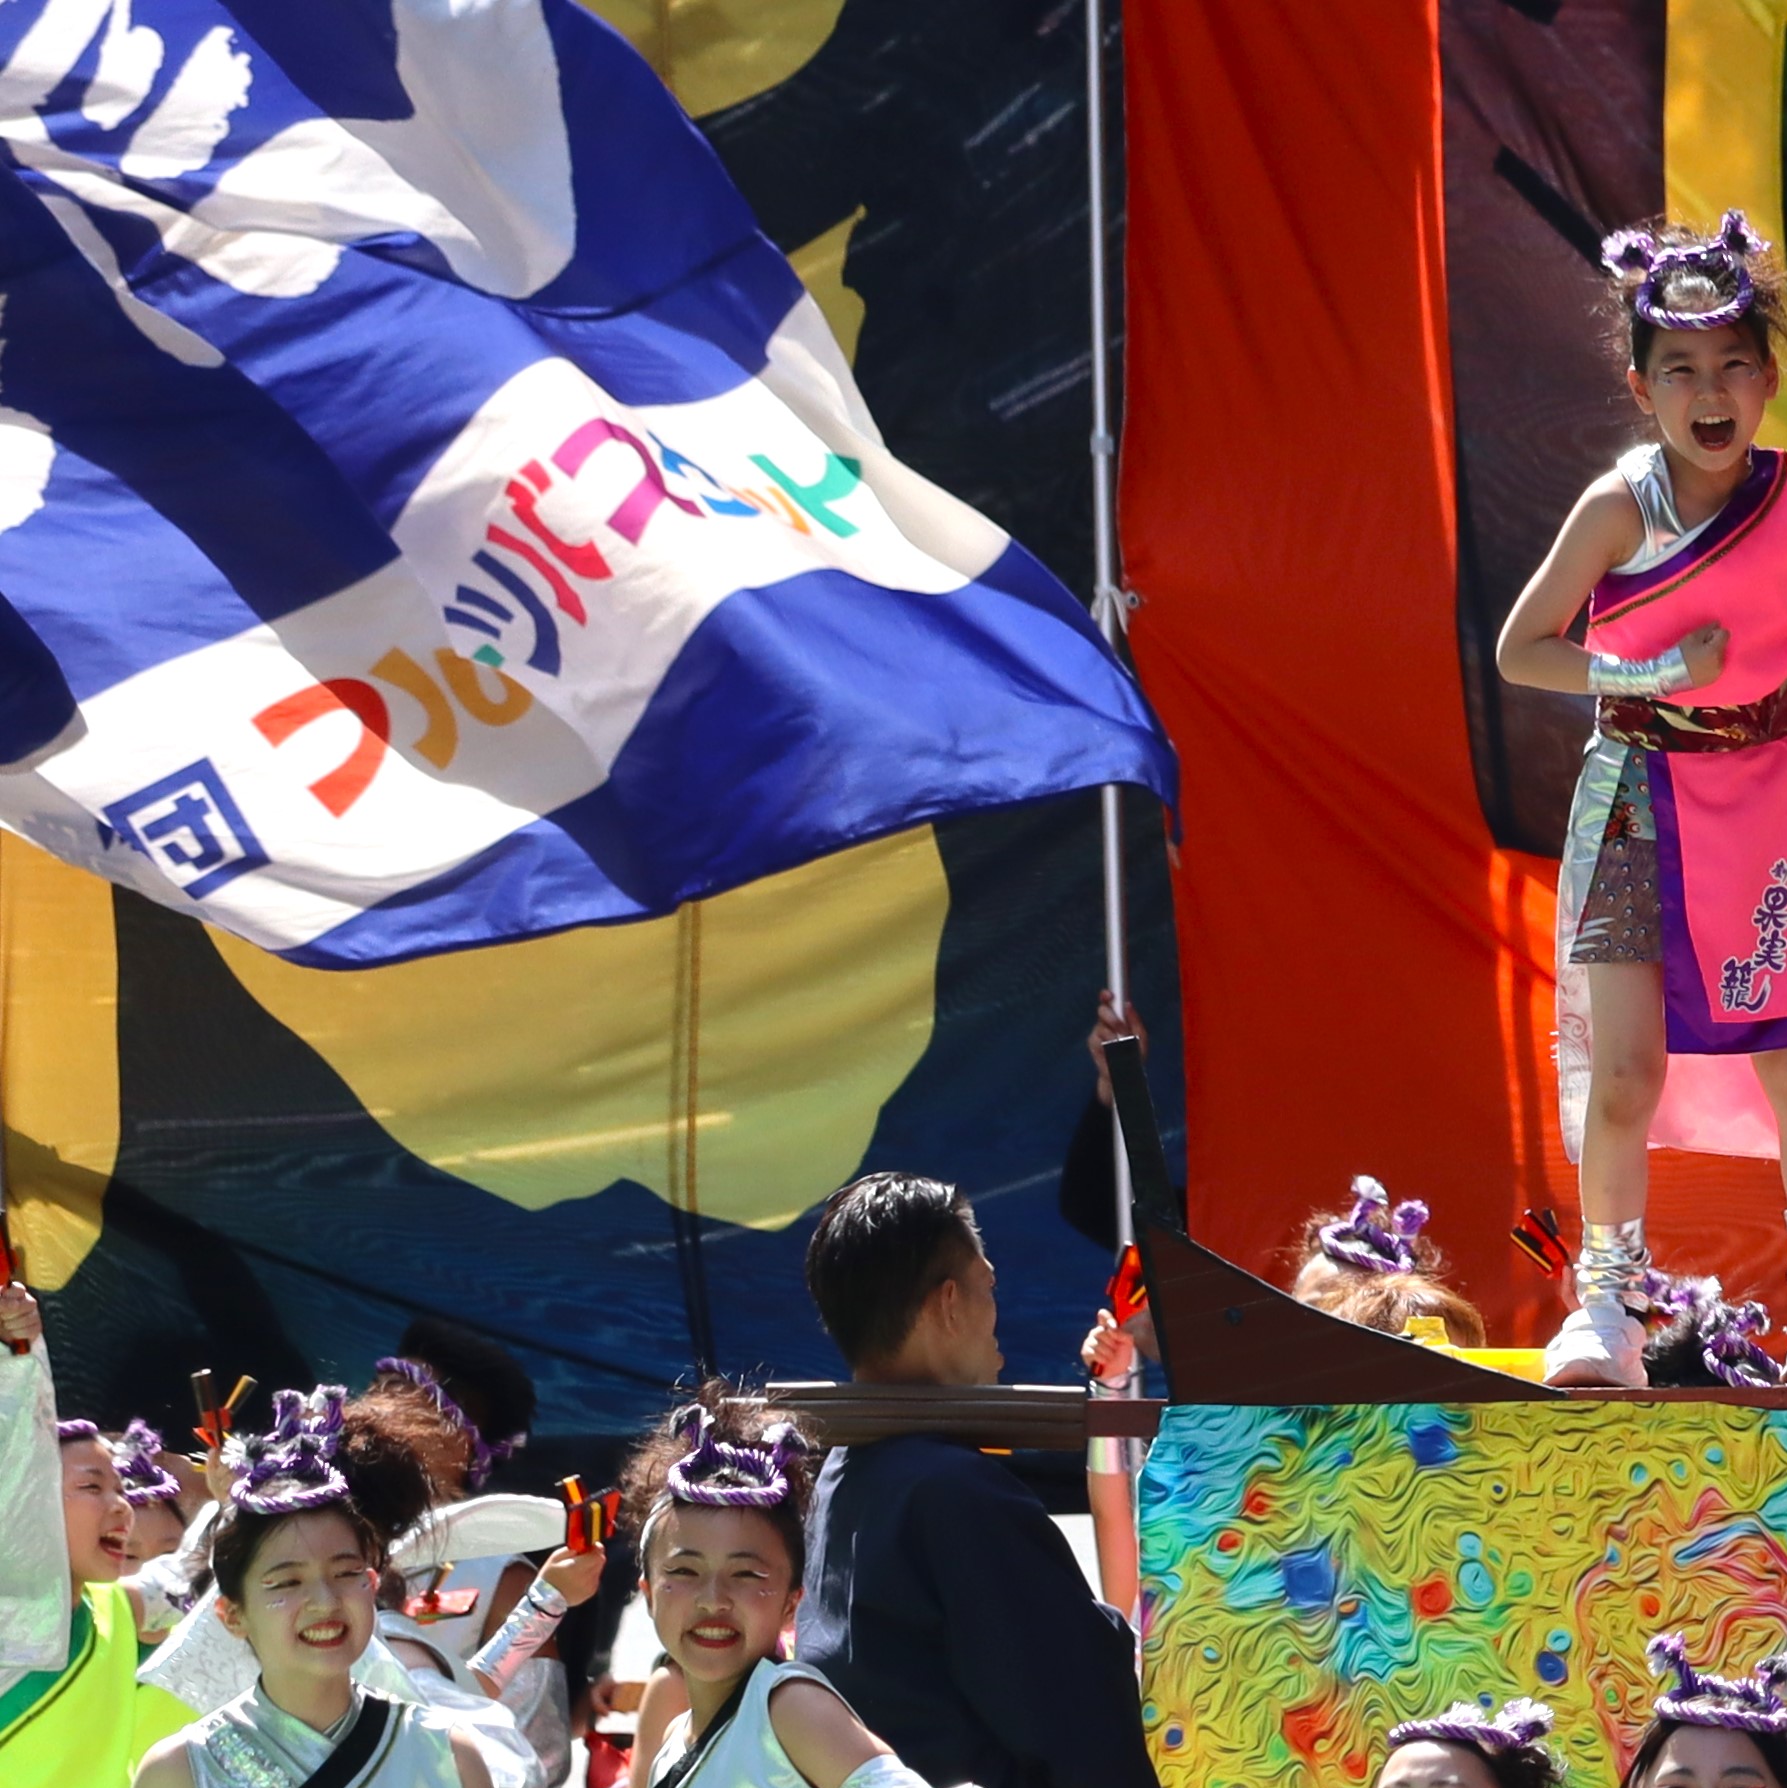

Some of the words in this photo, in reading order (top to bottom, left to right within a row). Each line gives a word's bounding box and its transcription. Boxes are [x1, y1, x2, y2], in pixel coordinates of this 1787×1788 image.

[100, 416, 862, 900] 団フルツバスケット
